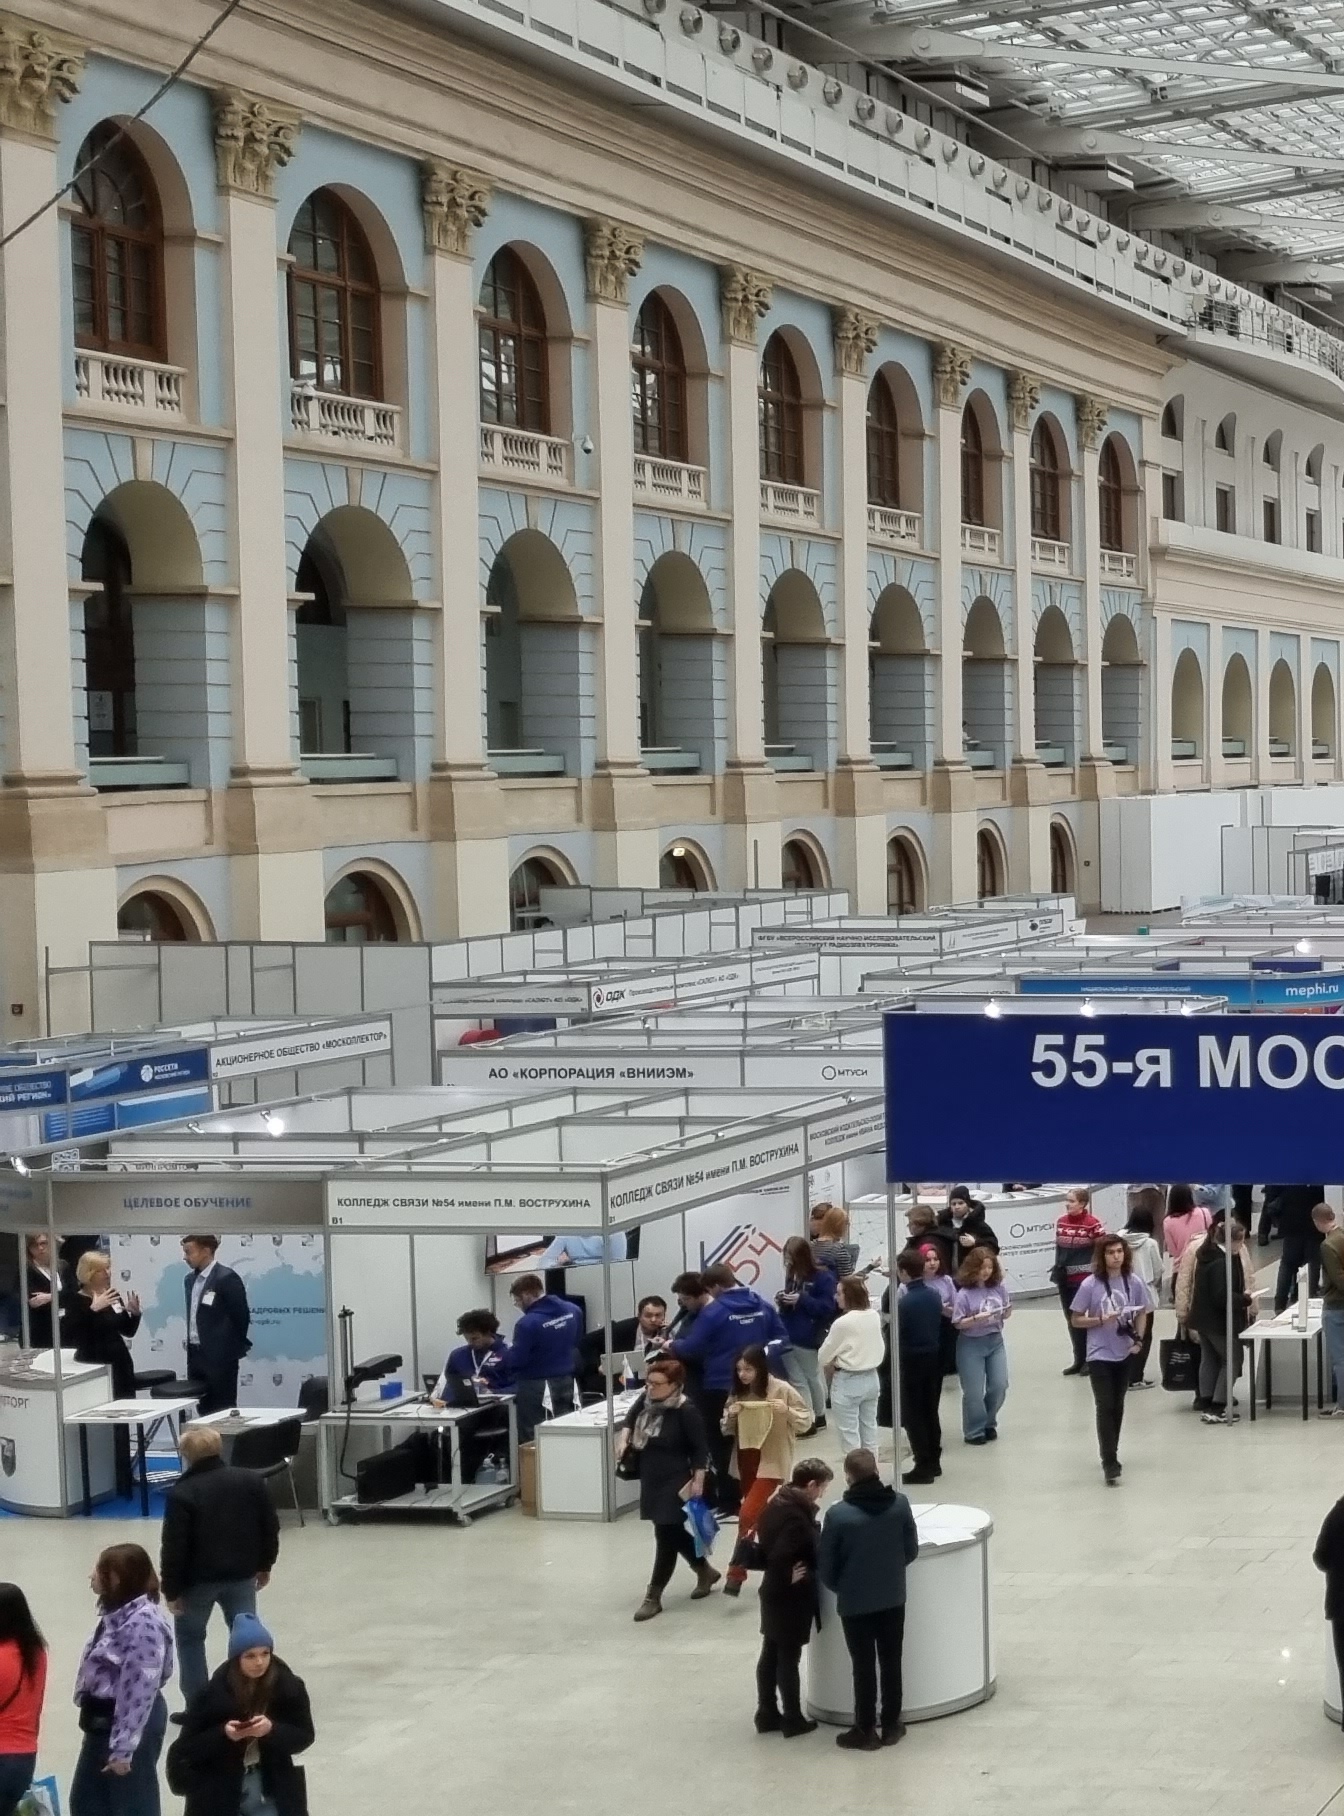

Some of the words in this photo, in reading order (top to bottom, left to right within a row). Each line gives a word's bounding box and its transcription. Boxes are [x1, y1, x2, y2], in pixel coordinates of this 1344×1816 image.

[606, 989, 627, 1002] ОДК
[1286, 983, 1339, 998] mephi.ru
[216, 1049, 275, 1067] АКЦИОНЕРНОЕ
[277, 1042, 320, 1058] ОБЩЕСТВО
[1031, 1034, 1171, 1088] 55-я
[488, 1068, 509, 1080] АО
[513, 1067, 615, 1080] «КОРПОРАЦИЯ
[620, 1067, 694, 1080] «ВНИИЭМ»
[838, 1068, 868, 1077] МТУСИ
[610, 1189, 654, 1209] КОЛЛЕДЖ
[655, 1177, 684, 1196] СВЯЗИ
[686, 1170, 704, 1186] №54
[705, 1166, 730, 1180] имени
[731, 1158, 747, 1172] П.М.
[749, 1142, 799, 1167] ВОСТРУХИНА
[123, 1197, 181, 1210] ЦЕЛЕВОЕ
[183, 1197, 252, 1209] ОБУЧЕНИЕ
[337, 1198, 389, 1208] КОЛЛЕДЖ
[392, 1198, 429, 1208] СВЯЗИ
[432, 1198, 455, 1208] №54
[458, 1200, 491, 1208] имени
[494, 1198, 515, 1208] П.М.
[519, 1198, 591, 1209] ВОСТРУХИНА
